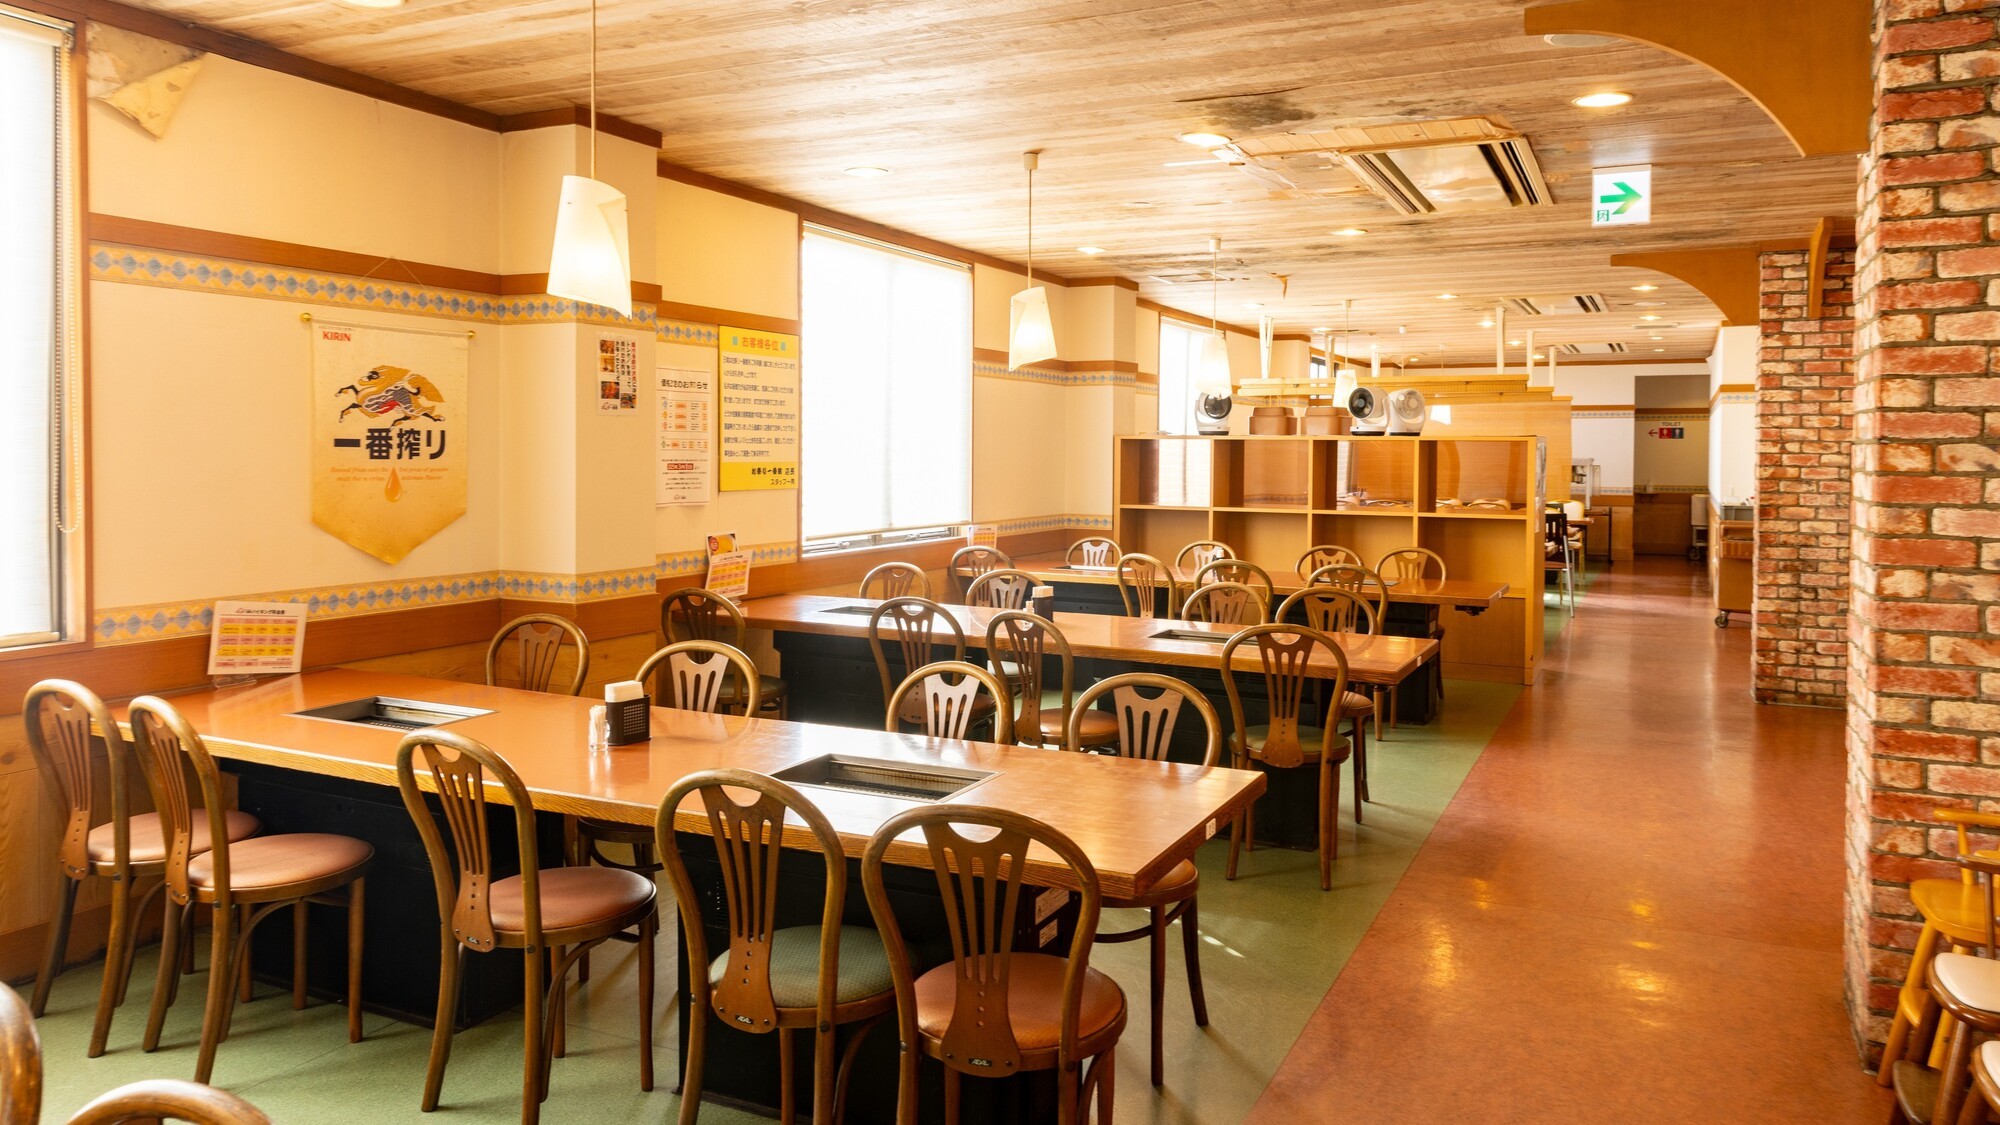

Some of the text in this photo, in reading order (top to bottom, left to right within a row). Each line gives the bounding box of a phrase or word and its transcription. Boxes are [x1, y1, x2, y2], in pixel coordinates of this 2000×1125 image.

[322, 331, 351, 342] KIRIN
[334, 428, 446, 460] 一番搾り
